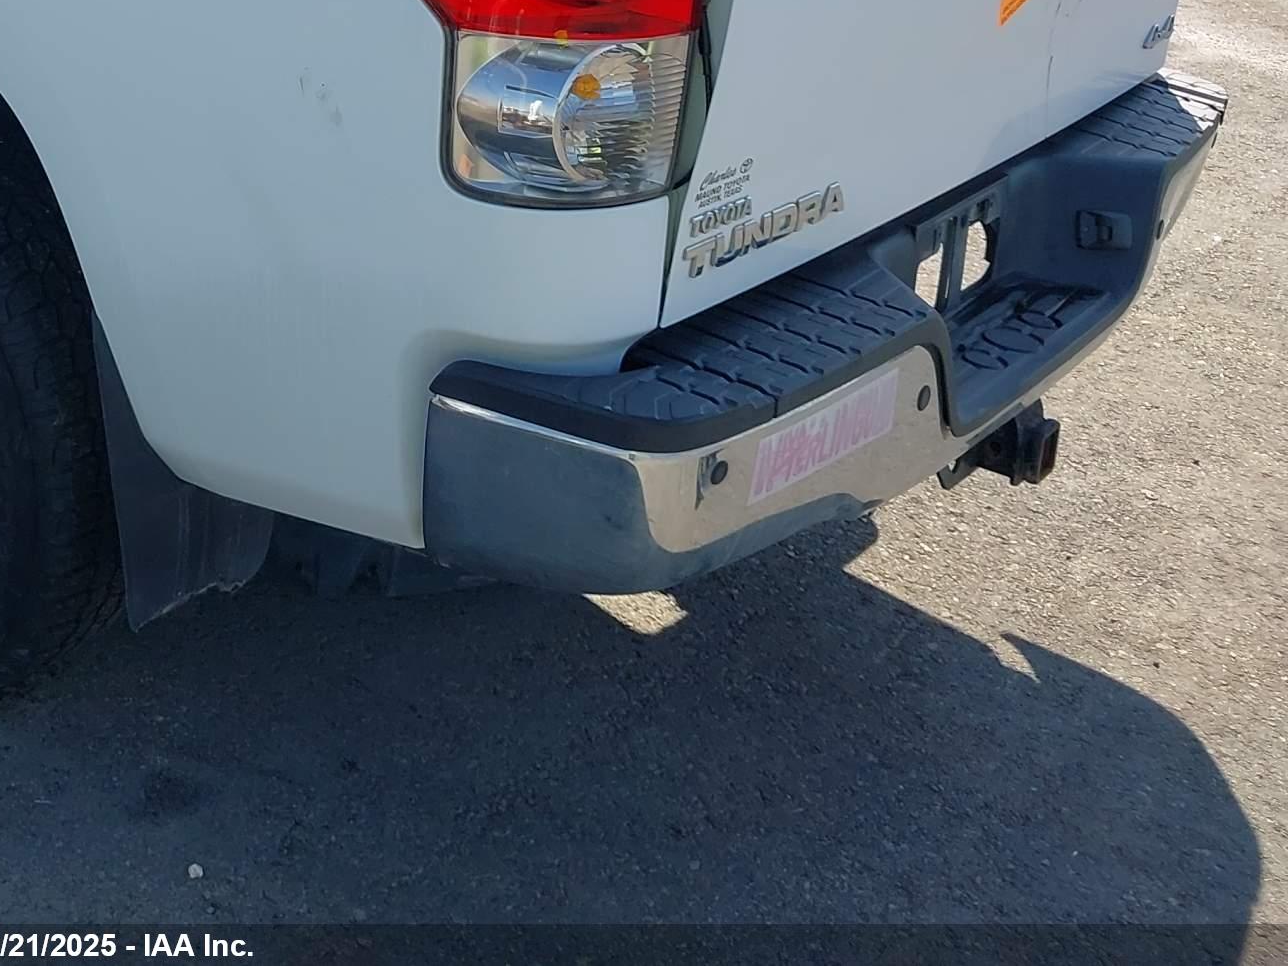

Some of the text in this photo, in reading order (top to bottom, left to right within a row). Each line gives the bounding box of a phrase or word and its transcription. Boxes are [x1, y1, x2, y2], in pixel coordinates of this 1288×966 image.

[724, 174, 751, 191] TOYOTA
[682, 181, 845, 278] TUNDRA
[689, 195, 753, 238] TOYOTA
